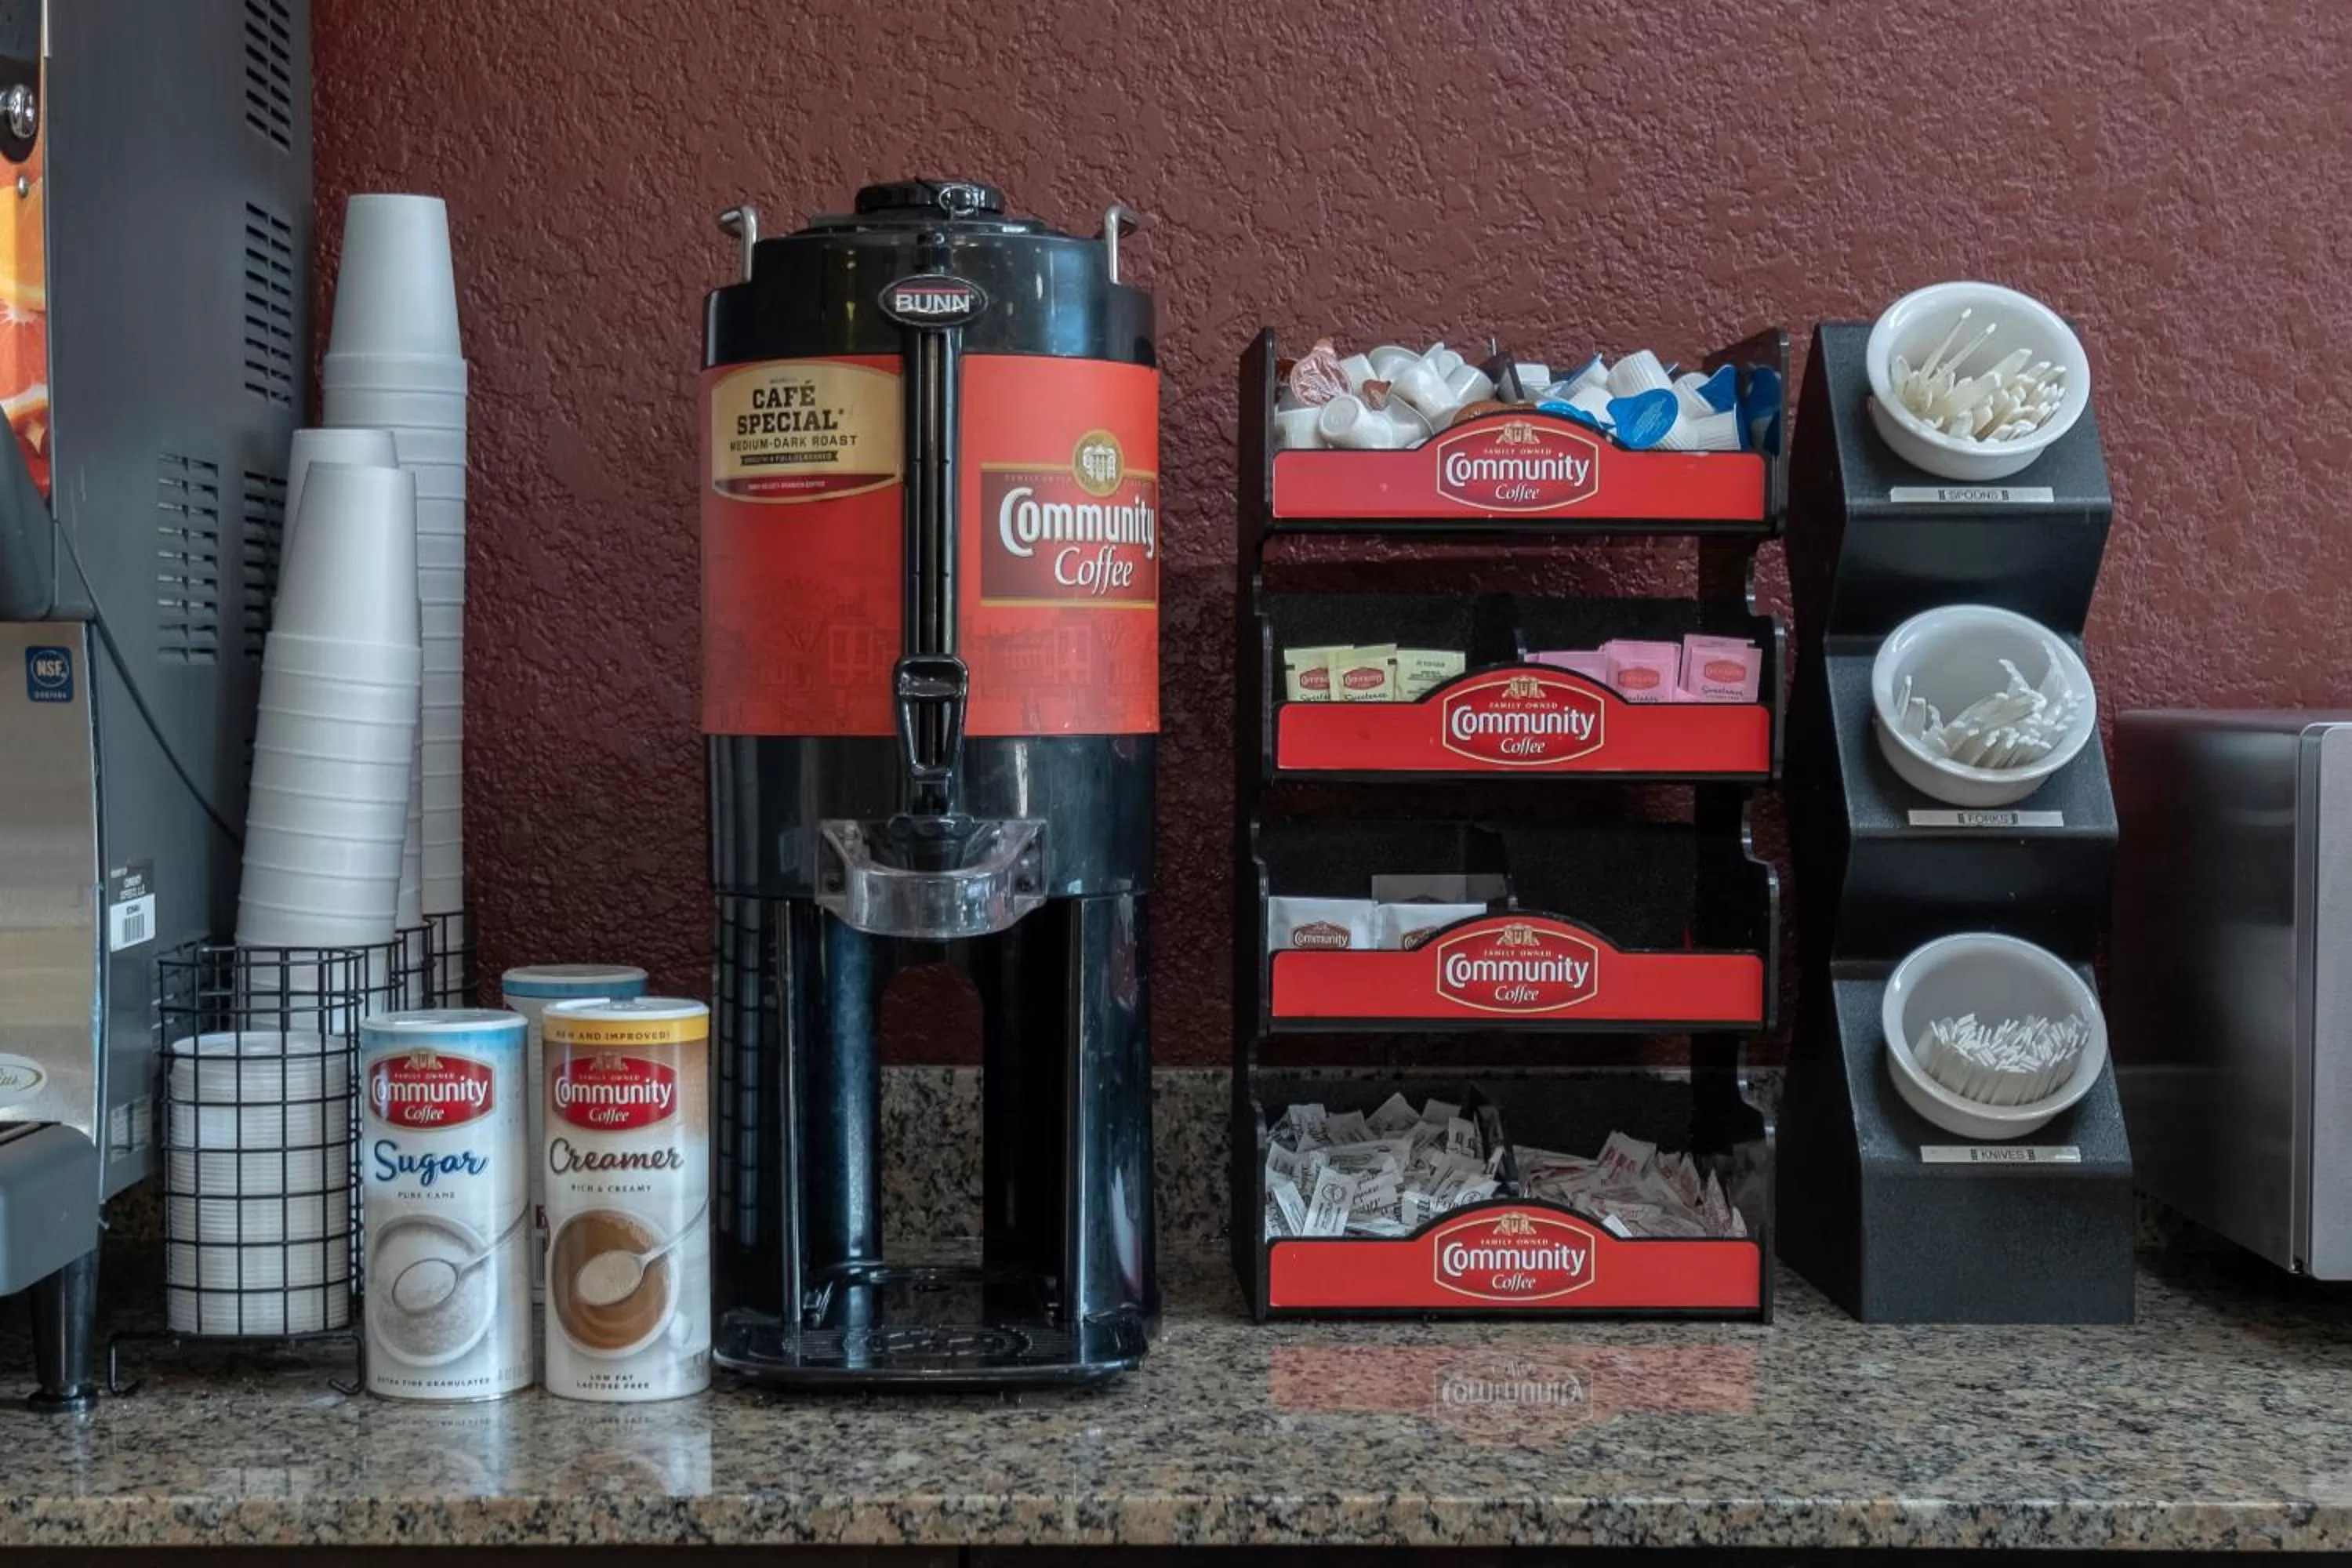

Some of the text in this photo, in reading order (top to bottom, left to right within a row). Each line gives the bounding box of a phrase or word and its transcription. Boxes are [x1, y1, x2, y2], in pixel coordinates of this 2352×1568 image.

[895, 294, 969, 313] BUNN
[753, 379, 816, 409] CAFÉ
[737, 408, 839, 435] SPECIAL
[730, 434, 858, 452] MEDIUM-DARK ROAST
[1446, 452, 1590, 487] Community
[1495, 482, 1541, 502] Coffee
[1000, 486, 1155, 560] Community
[1054, 545, 1133, 595] Coffee
[36, 660, 64, 677] NSF
[1452, 705, 1595, 741] Community
[1501, 736, 1545, 756] Coffee
[1294, 931, 1349, 946] Community
[1446, 953, 1589, 988] Community
[1494, 984, 1540, 1004] Coffee
[579, 1031, 601, 1040] AND
[372, 1074, 488, 1107] Community
[555, 1076, 672, 1109] Community
[404, 1105, 445, 1123] Coffee
[589, 1106, 630, 1125] Coffee
[374, 1139, 489, 1187] Sugar
[550, 1138, 684, 1174] Creamer
[1443, 1242, 1587, 1276] Community
[1492, 1273, 1537, 1292] Coffee
